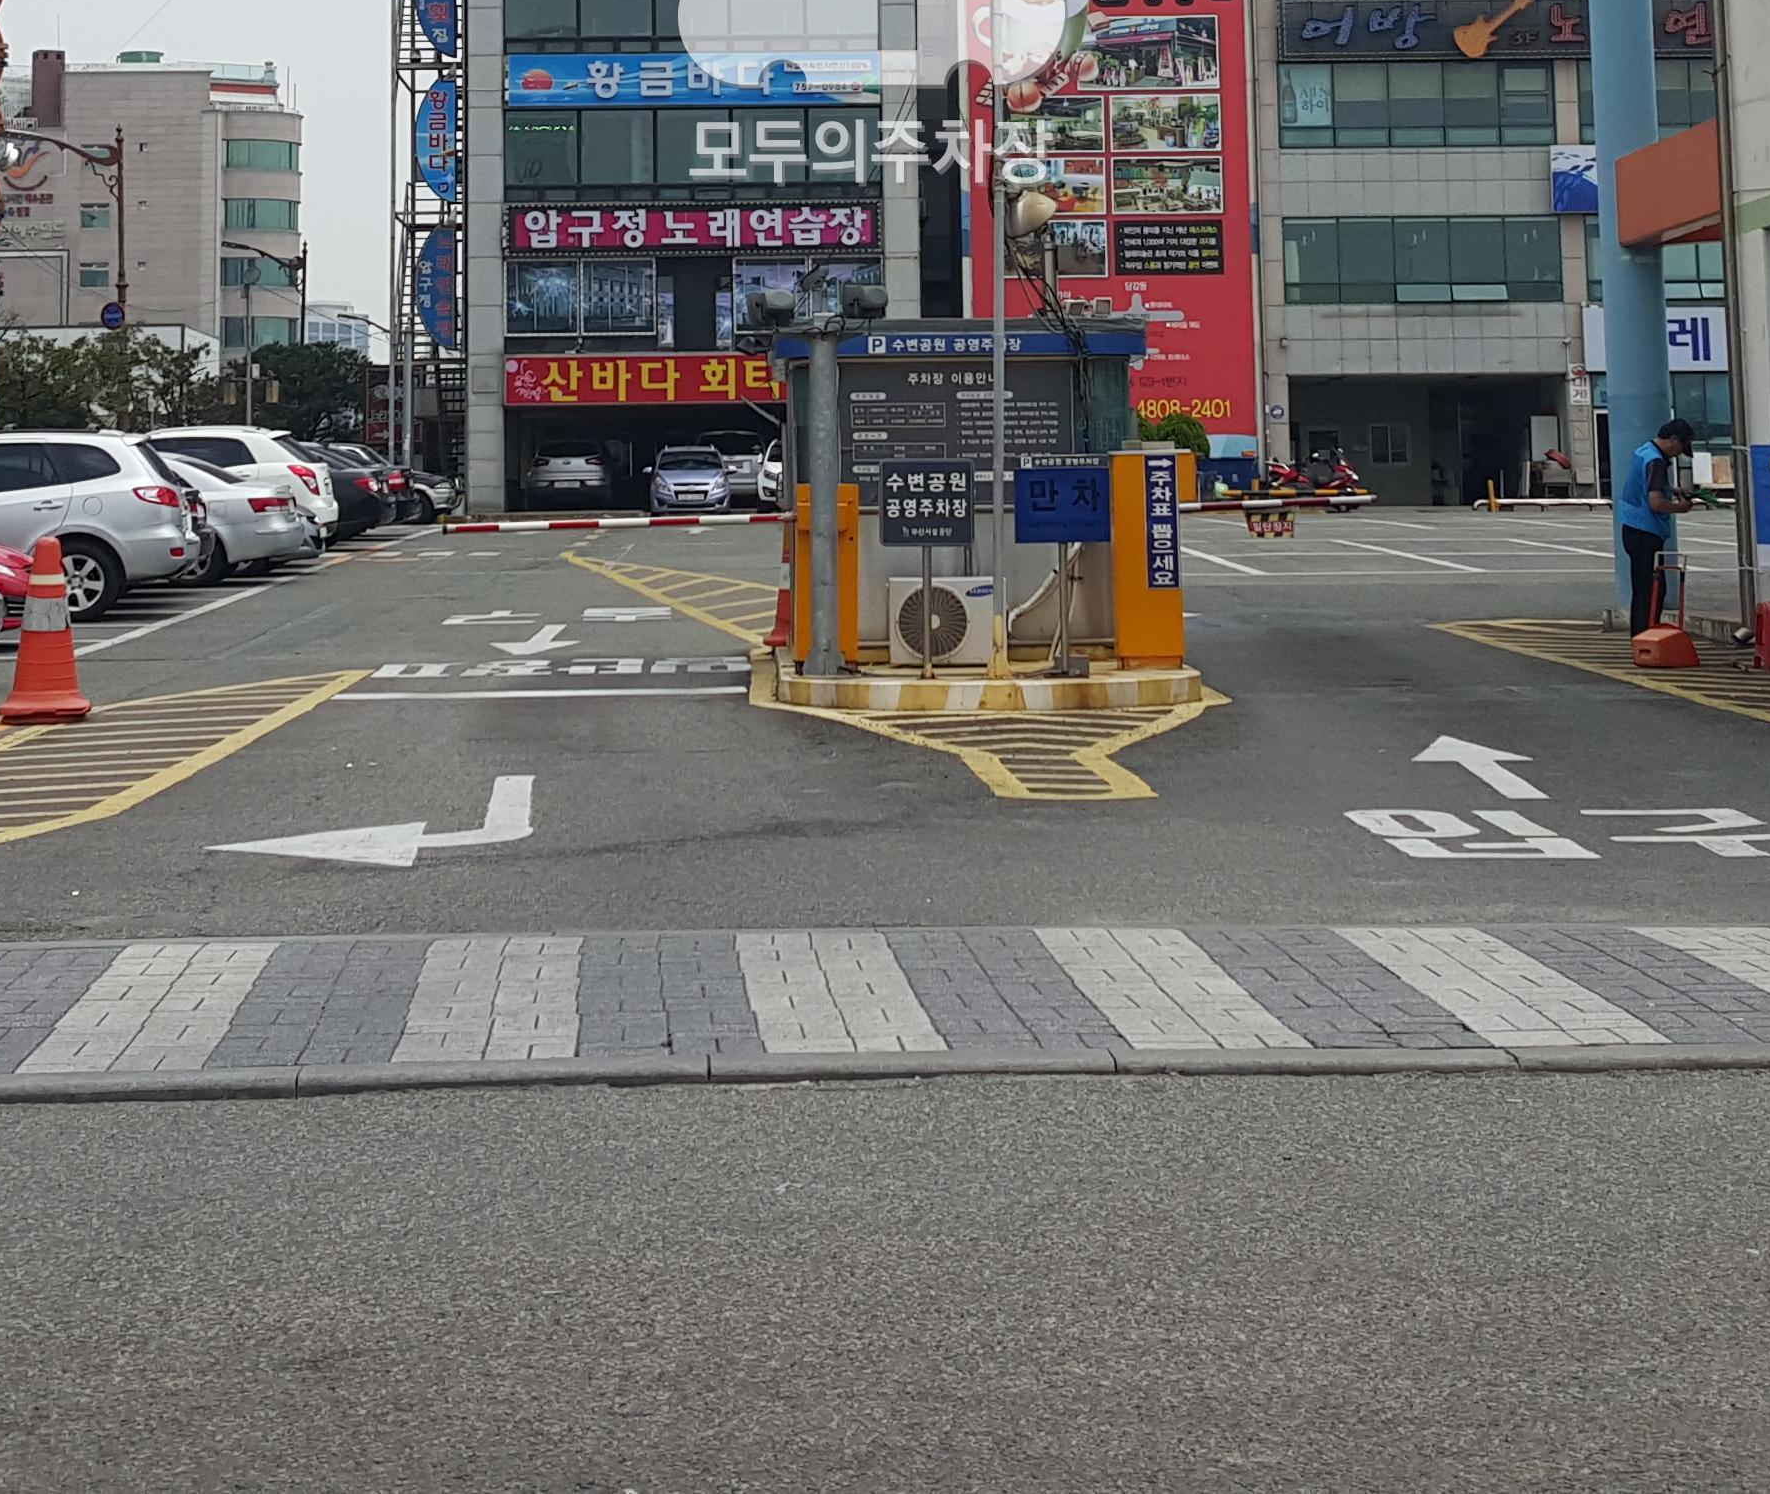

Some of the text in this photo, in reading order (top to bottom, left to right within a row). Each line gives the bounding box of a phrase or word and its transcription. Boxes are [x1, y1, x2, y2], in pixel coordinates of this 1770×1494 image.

[586, 59, 776, 100] 황금바다
[428, 90, 452, 174] 황금바다
[523, 206, 869, 248] 압구정 노래연습장
[891, 335, 947, 353] 수변공원
[1667, 316, 1713, 363] 레
[540, 356, 682, 402] 산바다
[906, 370, 945, 387] 주차장
[885, 472, 968, 493] 수변공원
[1029, 477, 1102, 514] 만차
[885, 497, 968, 520] 공영주차장
[1150, 469, 1176, 587] 주차표 뽑으세요
[1250, 520, 1294, 534] 일단정지
